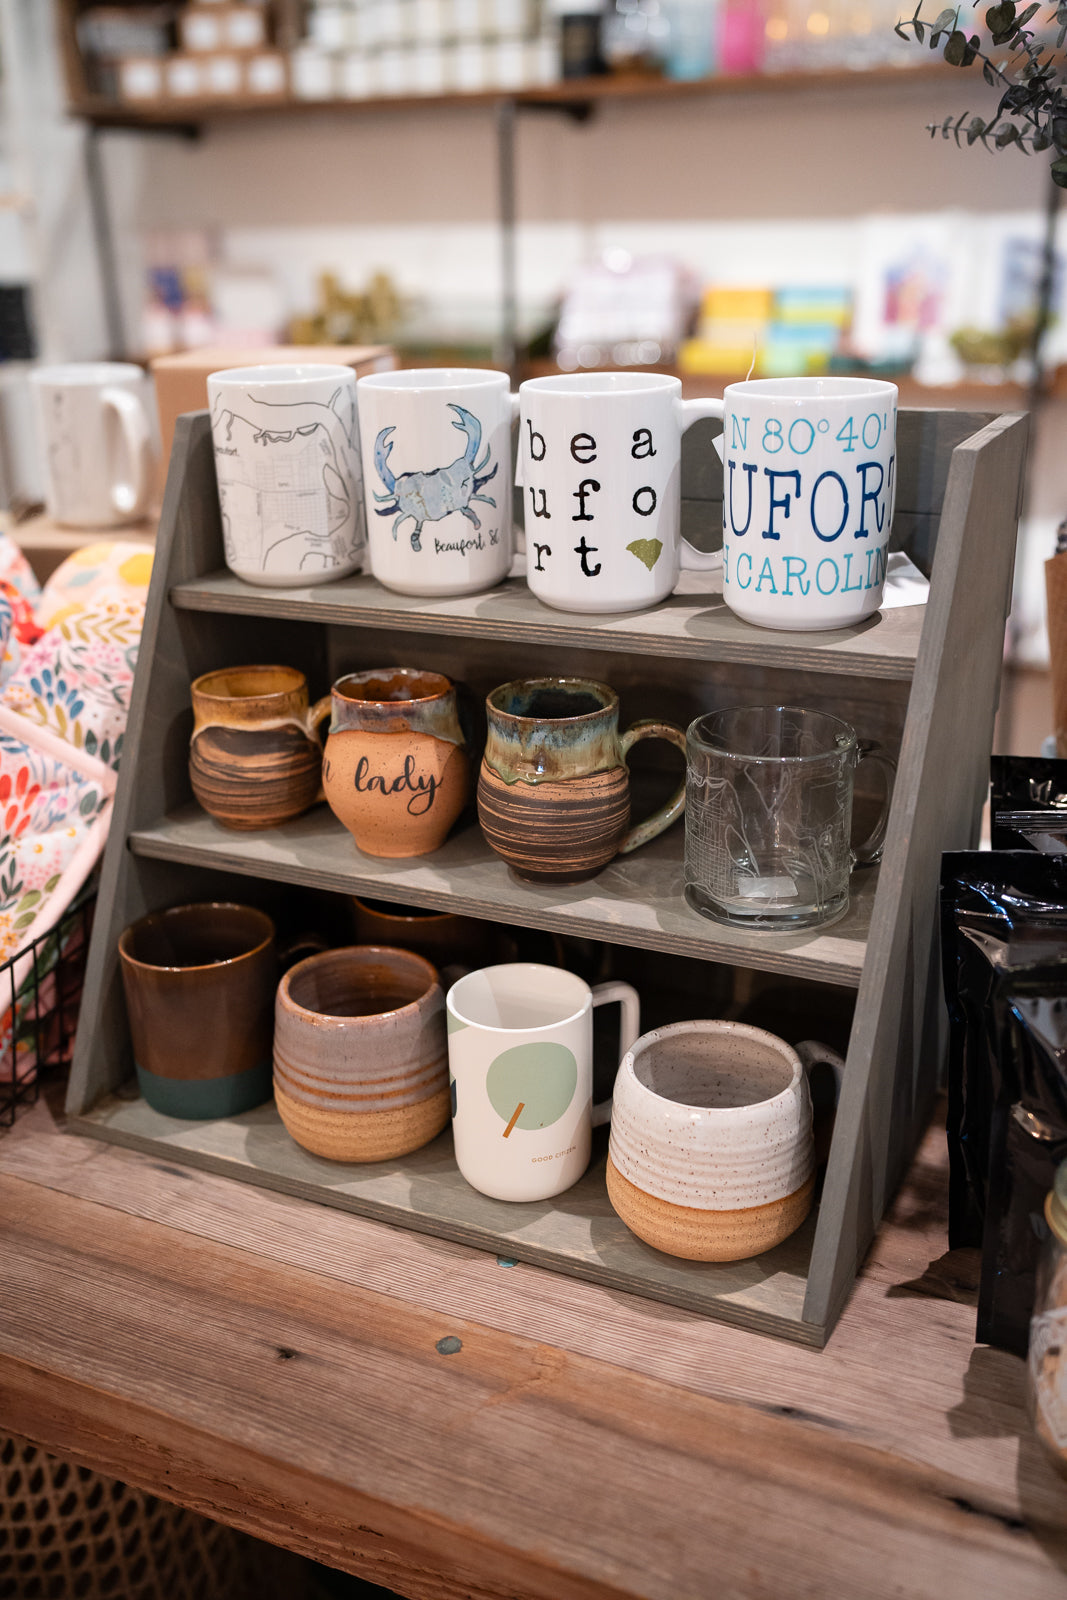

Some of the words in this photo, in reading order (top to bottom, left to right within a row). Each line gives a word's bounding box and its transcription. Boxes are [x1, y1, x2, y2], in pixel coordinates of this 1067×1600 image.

[526, 418, 547, 461] b
[570, 432, 598, 465] e
[631, 428, 657, 460] a
[731, 413, 751, 451] N
[529, 485, 552, 520] u
[571, 478, 601, 522] f
[632, 485, 657, 517] o
[533, 542, 552, 572] r
[573, 535, 602, 578] t
[354, 755, 444, 816] lady
[531, 1154, 554, 1163] GOOD
